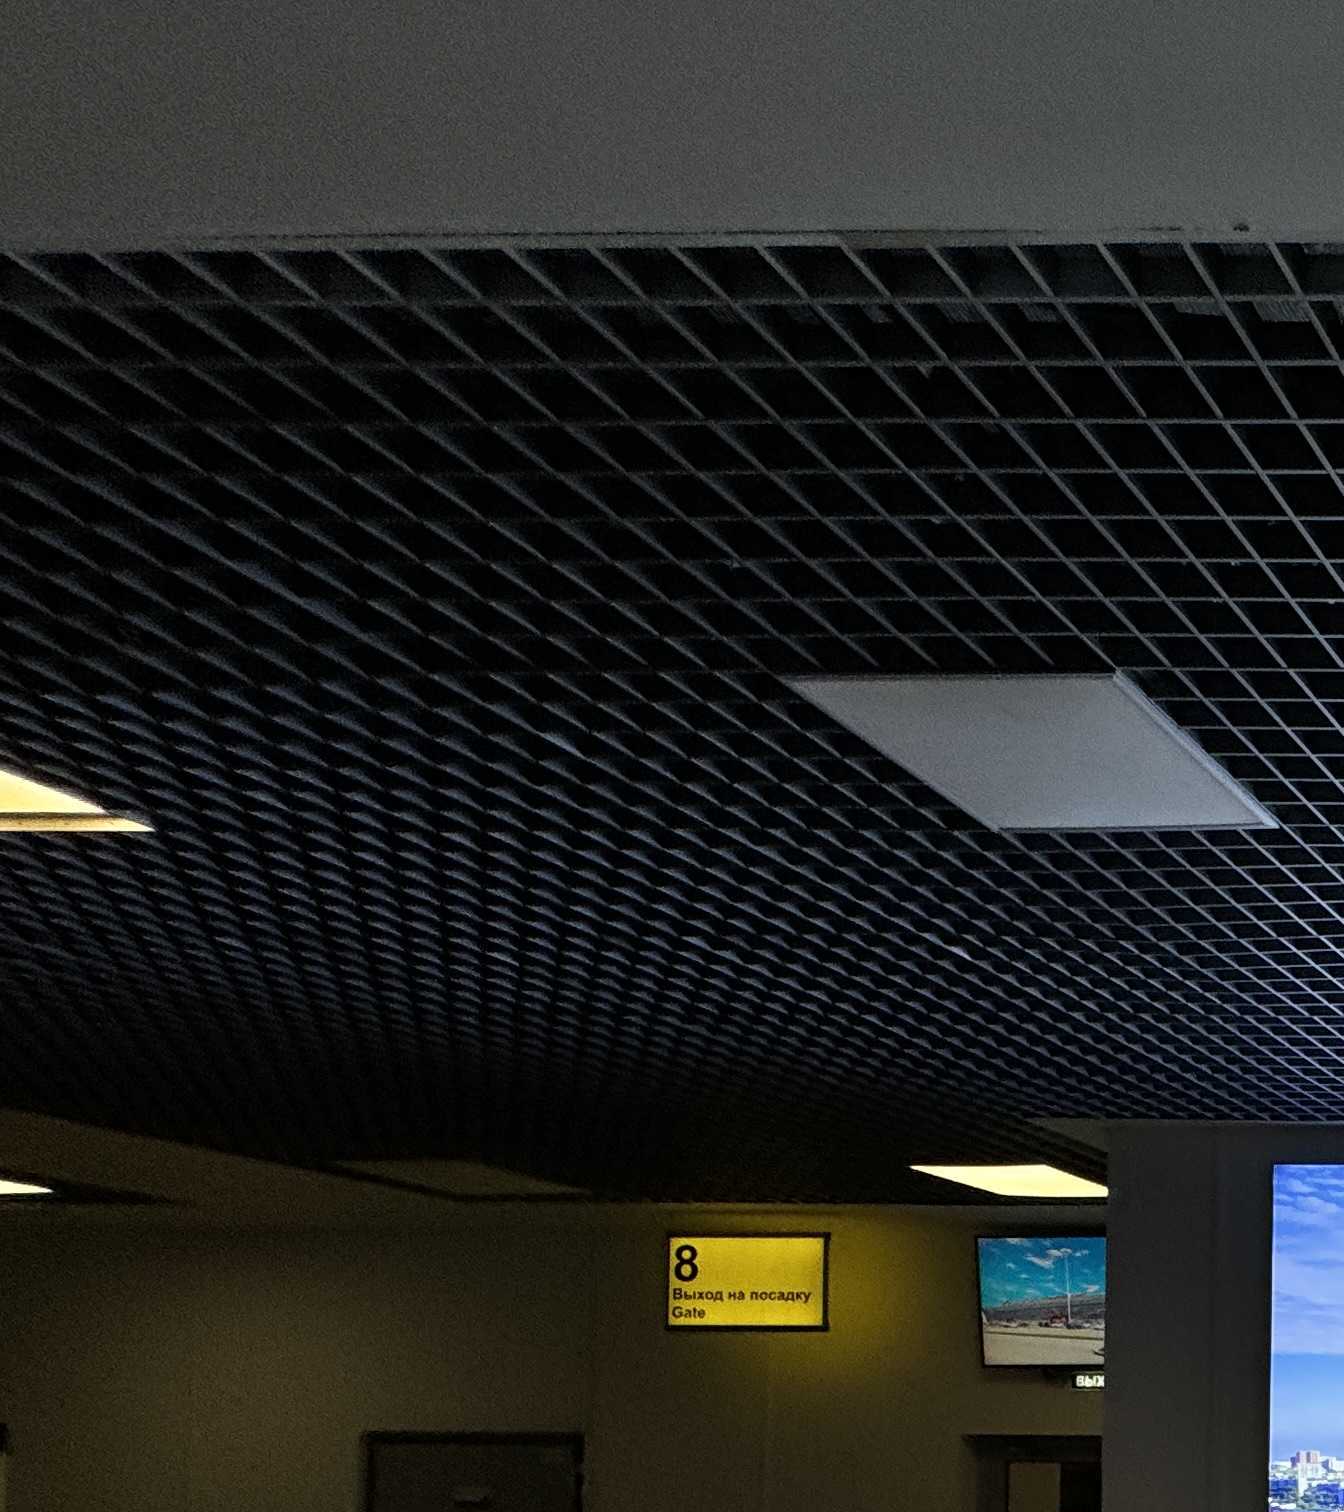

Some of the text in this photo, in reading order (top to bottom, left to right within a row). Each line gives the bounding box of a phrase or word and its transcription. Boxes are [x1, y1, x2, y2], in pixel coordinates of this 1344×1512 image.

[674, 1244, 699, 1282] 8
[672, 1288, 812, 1303] Выход на посадку
[672, 1306, 706, 1319] Gate
[1076, 1375, 1105, 1388] ВЫХ
